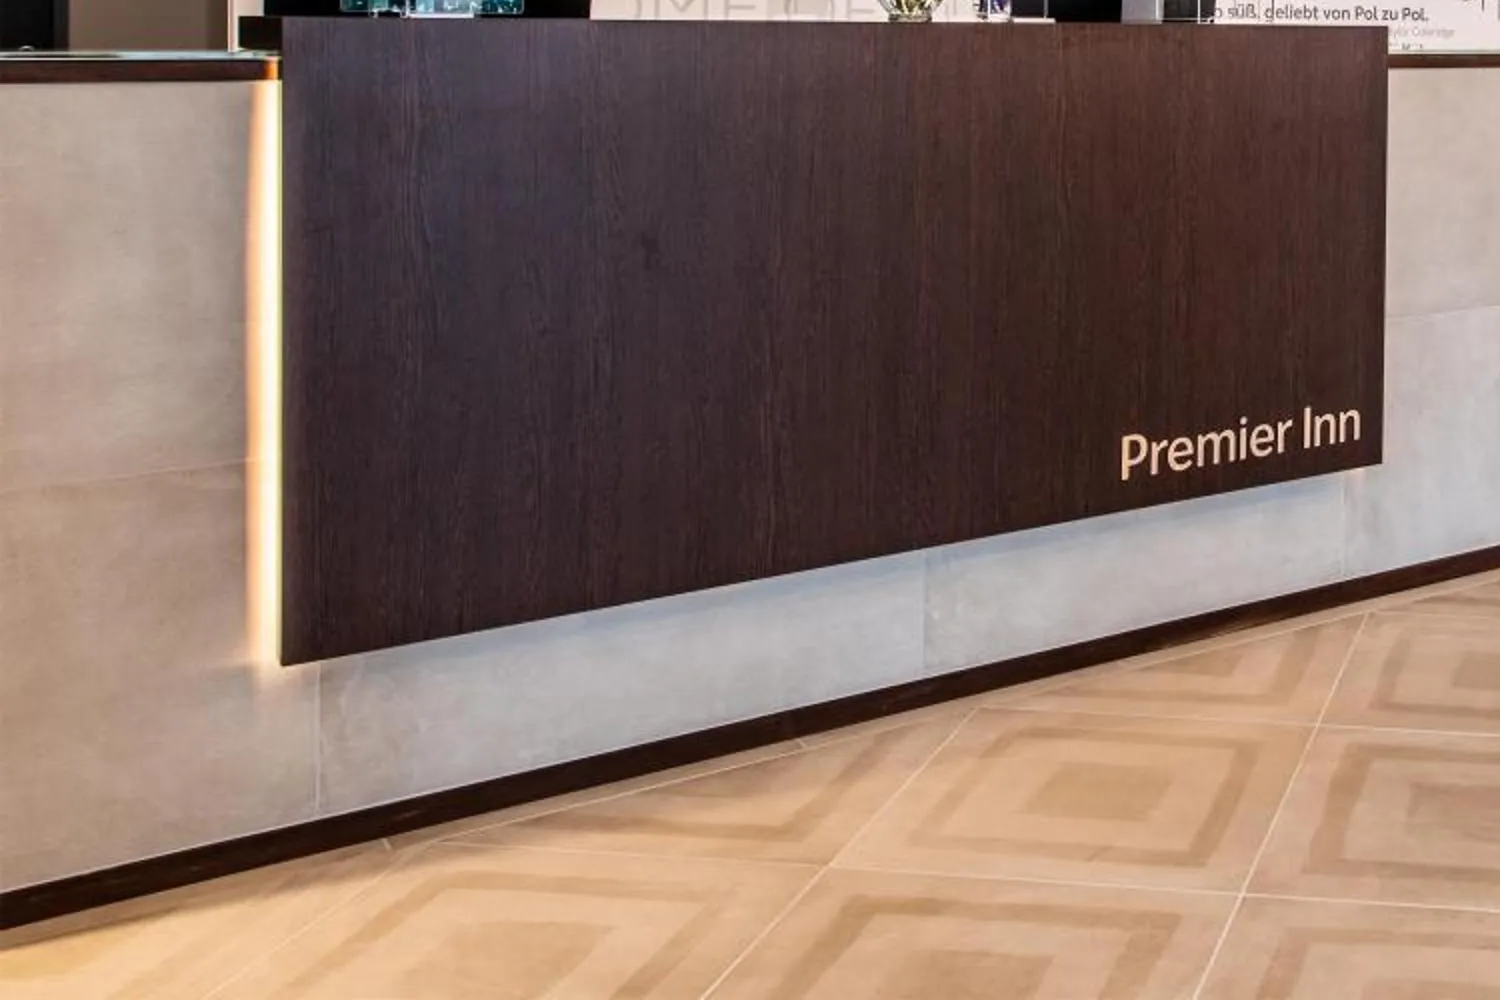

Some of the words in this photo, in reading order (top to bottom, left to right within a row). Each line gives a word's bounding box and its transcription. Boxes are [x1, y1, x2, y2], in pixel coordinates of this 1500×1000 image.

[1264, 4, 1318, 22] geliebt
[1323, 8, 1351, 21] von
[1355, 5, 1379, 21] Pol
[1382, 8, 1399, 21] zu
[1402, 6, 1430, 22] Pol.
[1120, 416, 1293, 481] Premier
[1303, 405, 1361, 449] Inn
